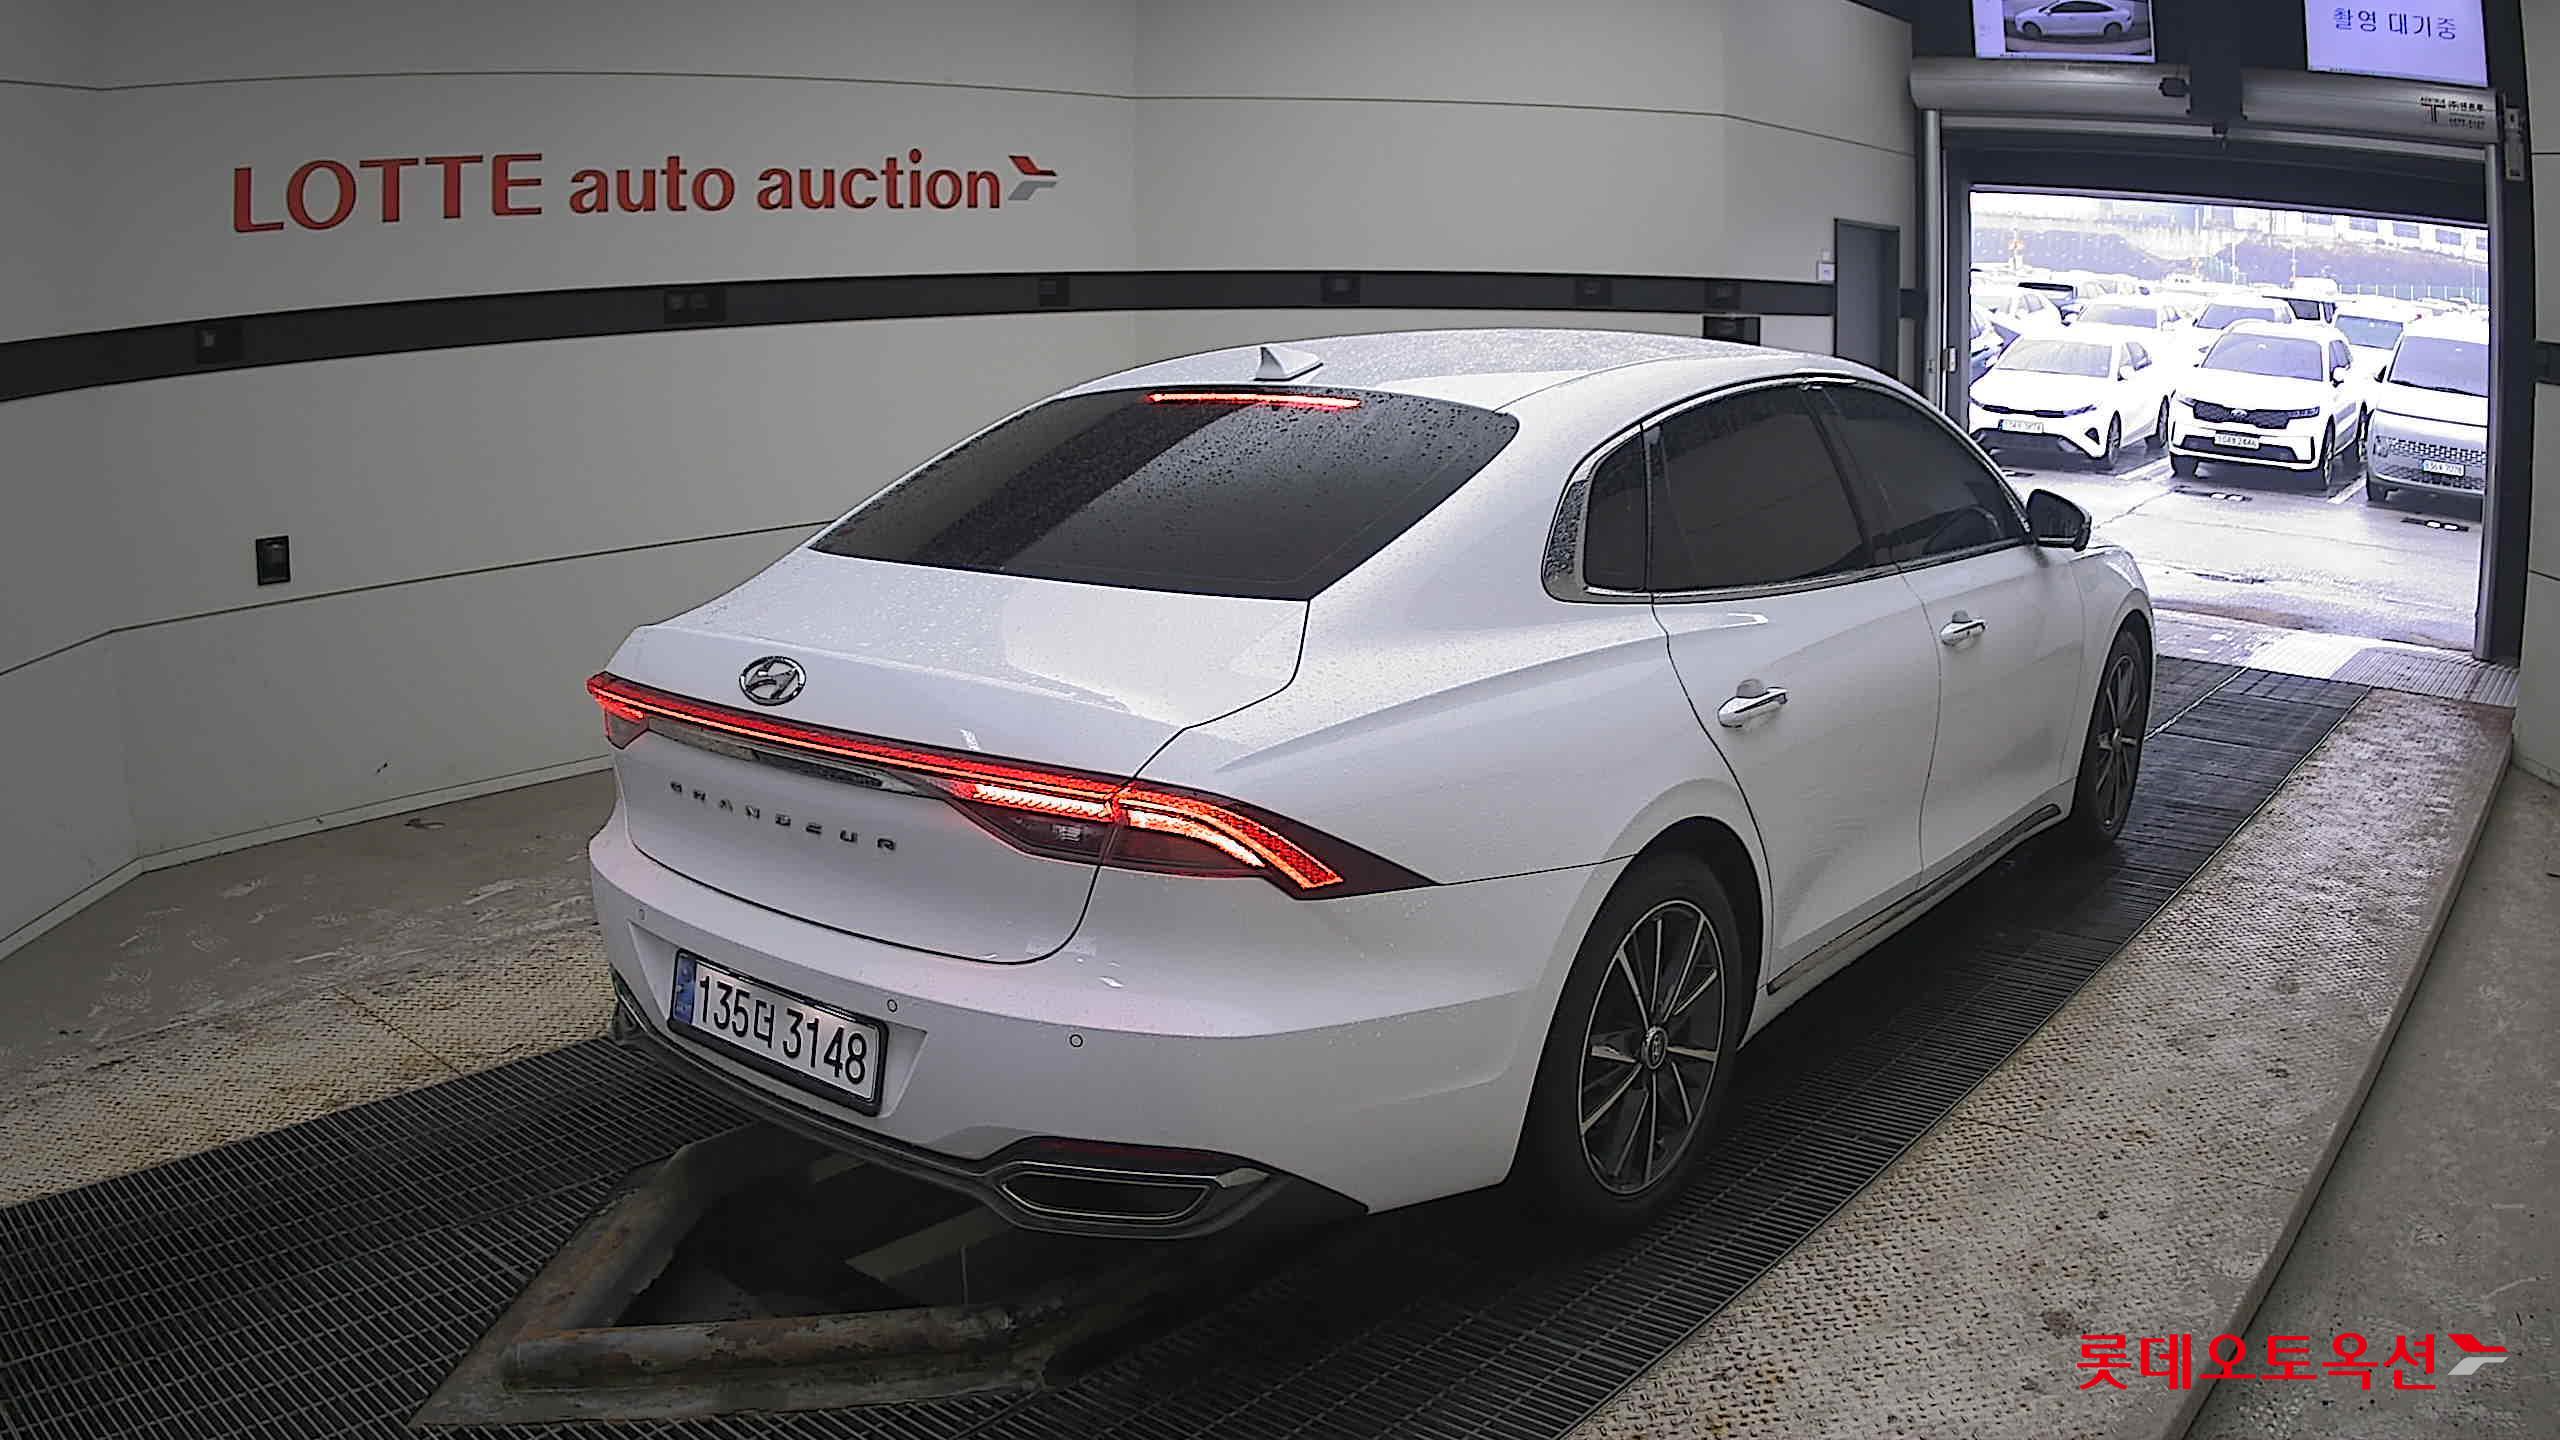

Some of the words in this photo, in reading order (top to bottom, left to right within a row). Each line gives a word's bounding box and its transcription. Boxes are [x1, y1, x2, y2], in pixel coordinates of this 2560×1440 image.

[2334, 7, 2377, 32] 촬영
[2389, 13, 2456, 40] 대기중
[234, 152, 543, 233] LOTTE
[569, 155, 736, 214] auto
[758, 148, 1000, 210] auction
[699, 976, 775, 1049] 135더
[783, 1008, 867, 1084] 3148
